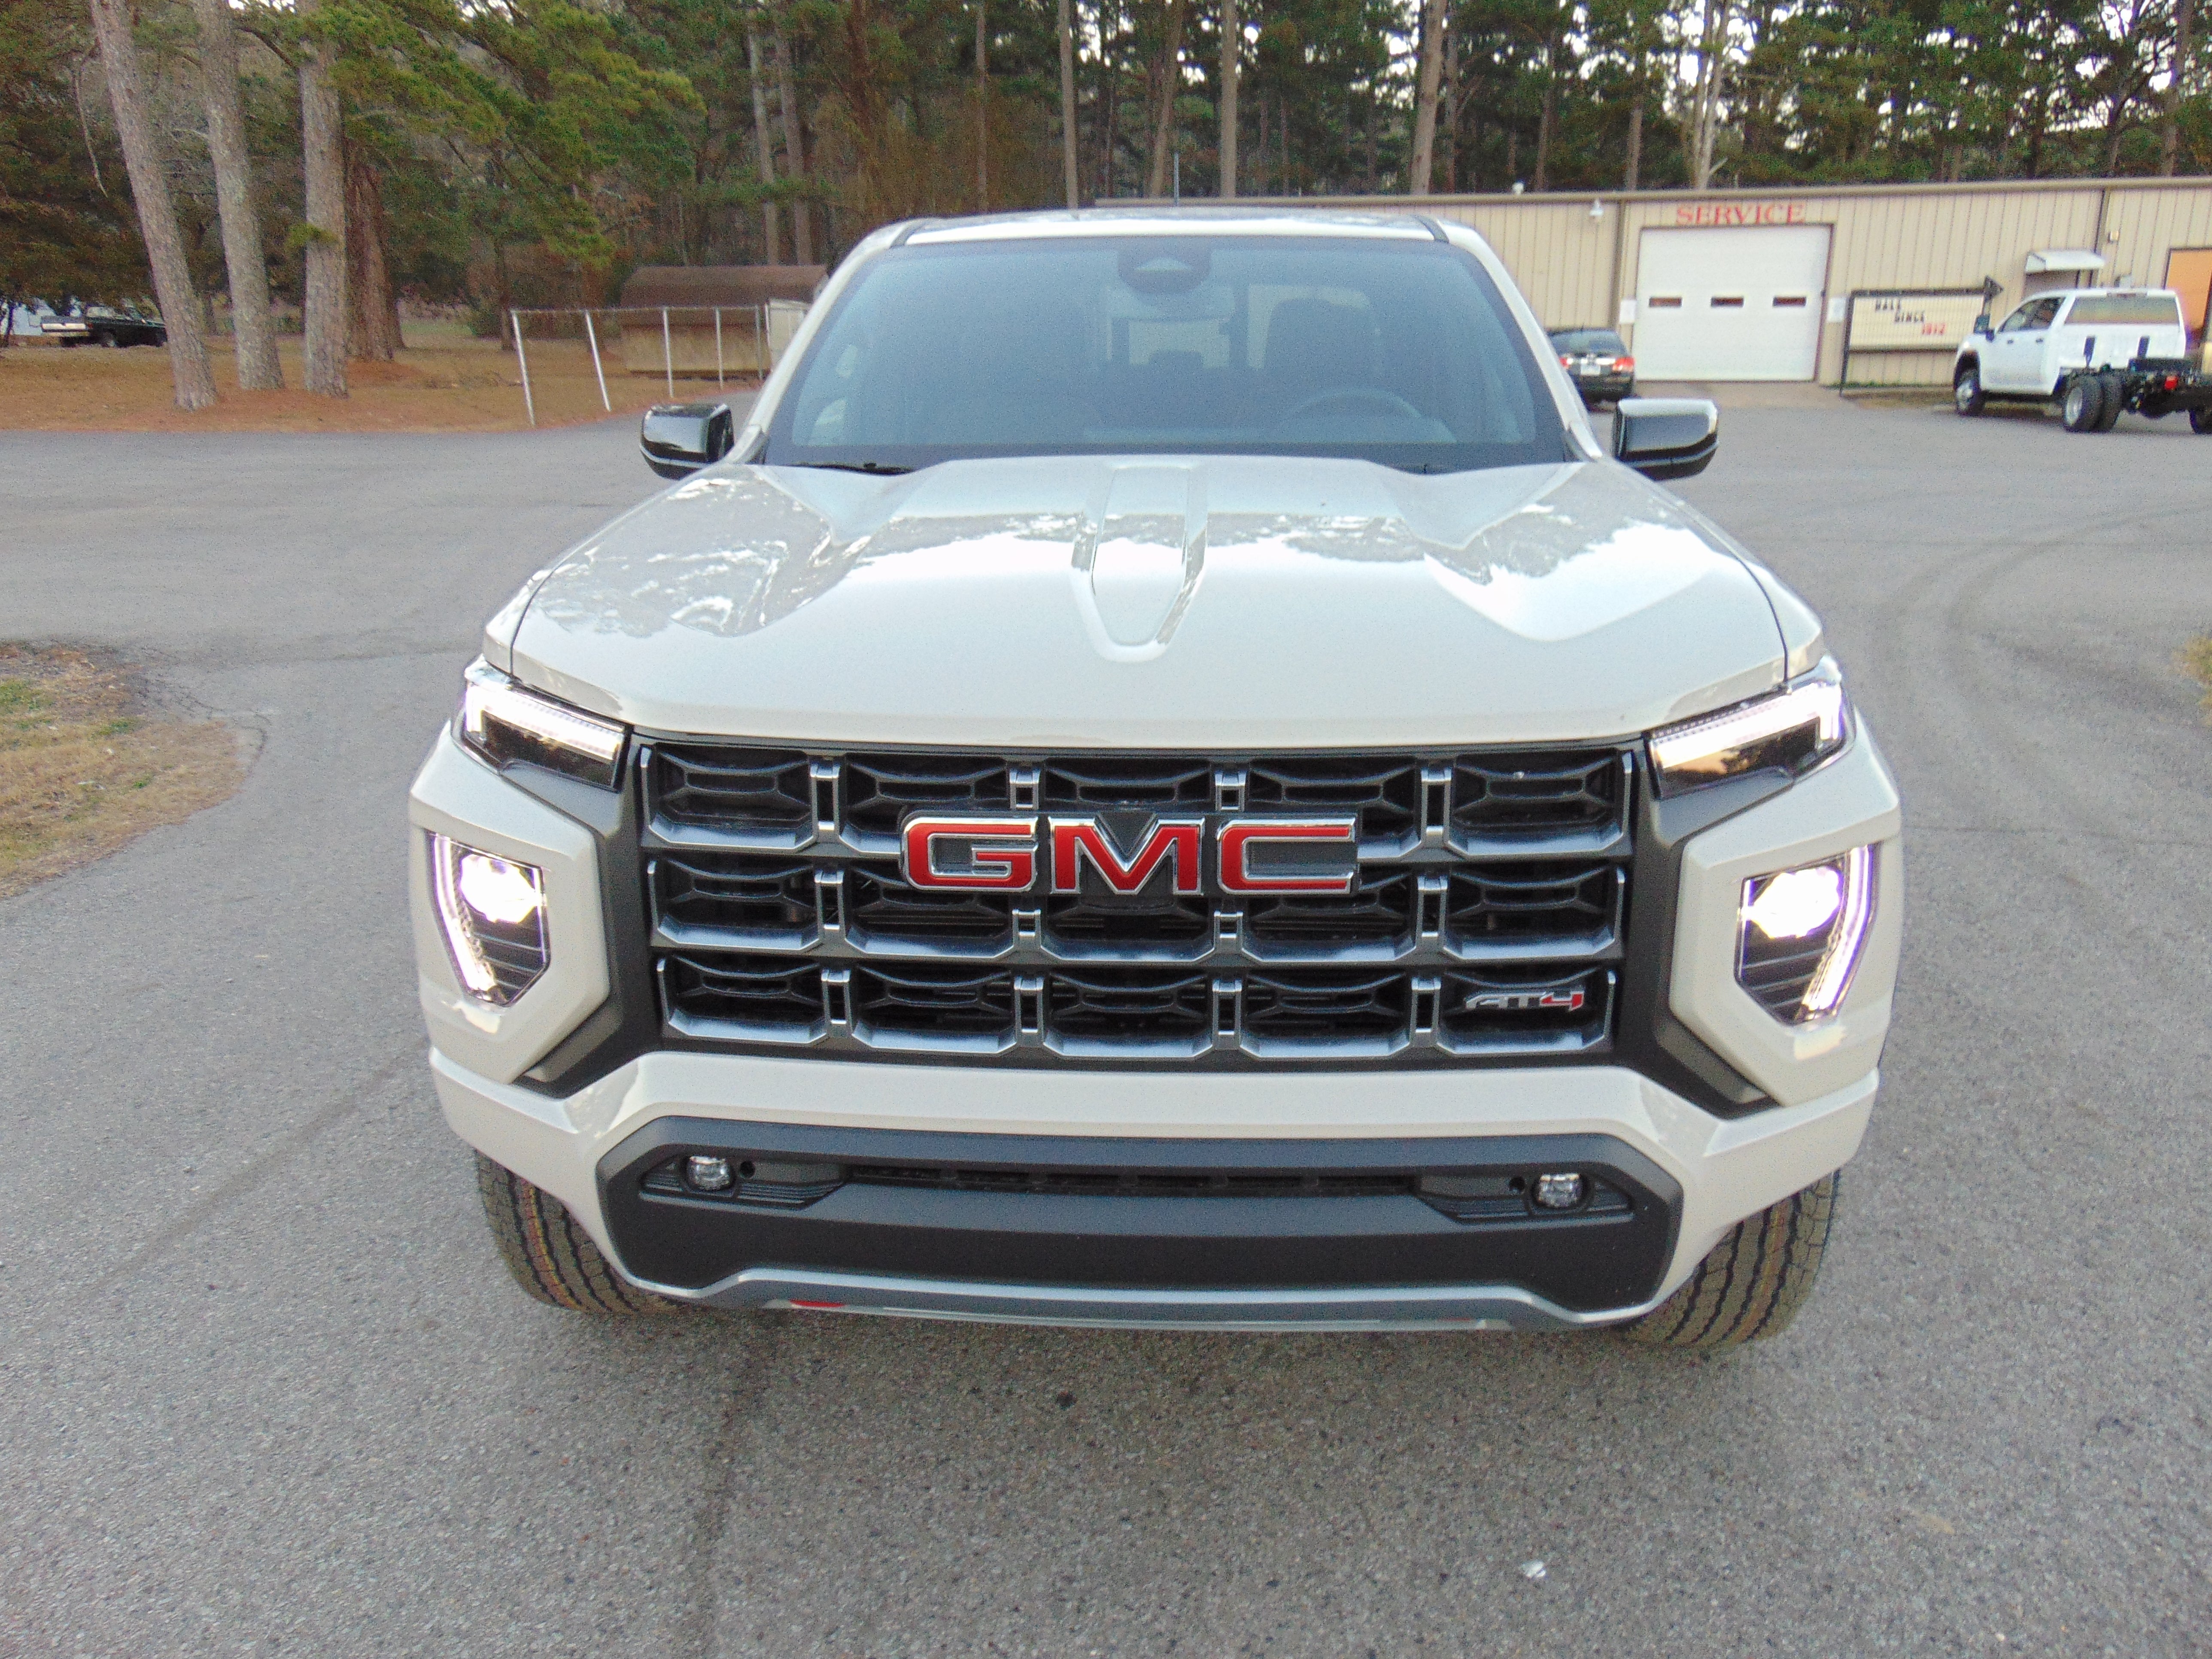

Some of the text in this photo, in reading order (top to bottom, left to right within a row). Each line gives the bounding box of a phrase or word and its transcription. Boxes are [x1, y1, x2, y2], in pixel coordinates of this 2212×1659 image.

[1676, 202, 1806, 225] SERVICE
[903, 816, 1356, 895] GMC
[1464, 991, 1585, 1011] AT4
